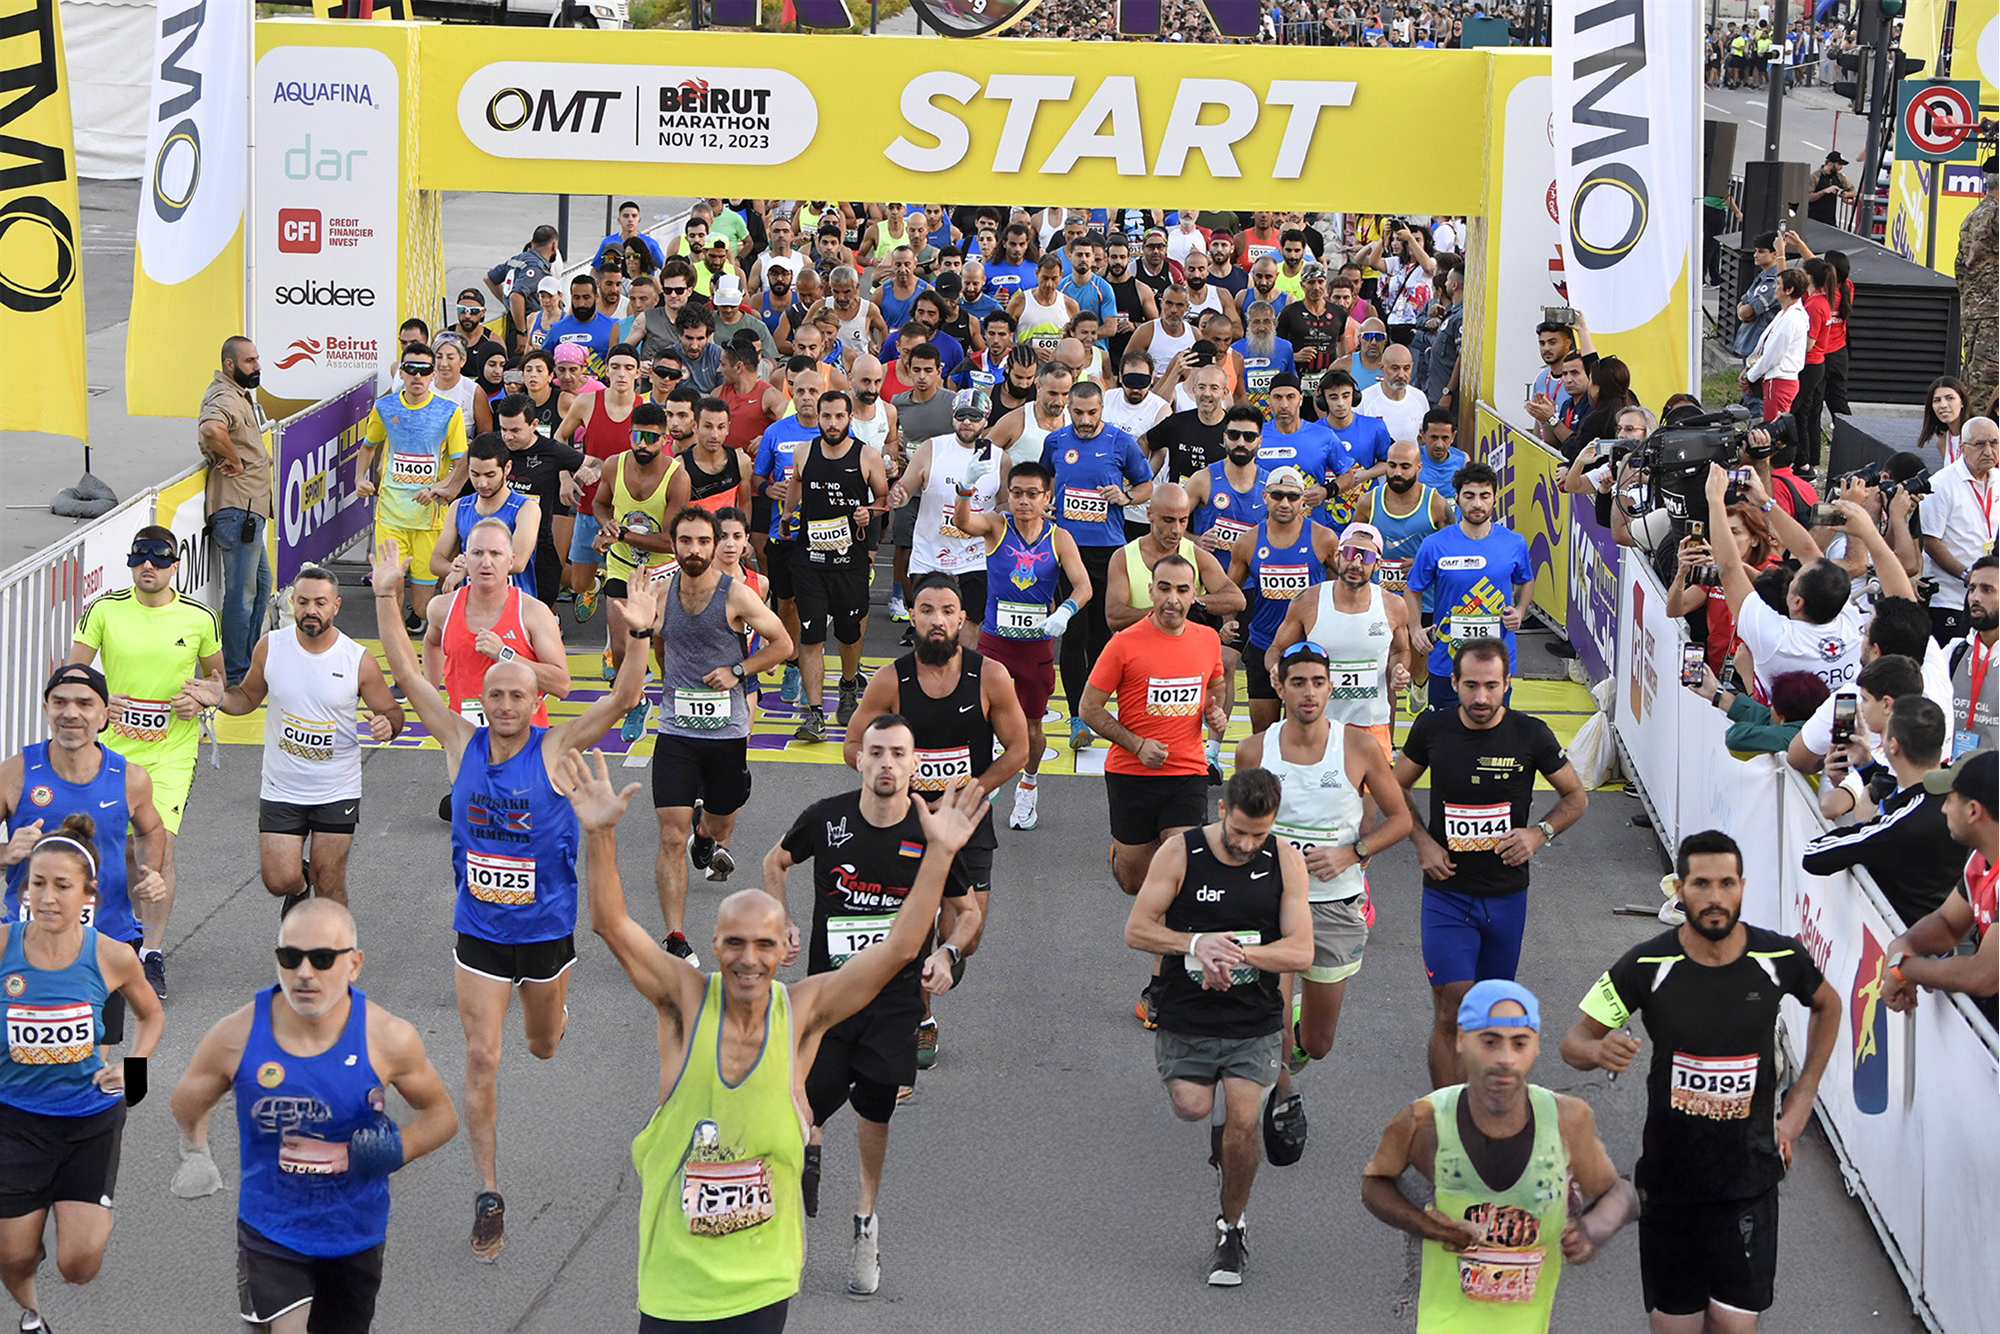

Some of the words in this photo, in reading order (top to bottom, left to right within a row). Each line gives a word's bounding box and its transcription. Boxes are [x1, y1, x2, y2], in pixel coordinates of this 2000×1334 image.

[273, 81, 373, 106] AQUAFINA
[659, 86, 771, 115] BEIRUT
[485, 87, 622, 134] OMT
[659, 115, 770, 131] MARATHON
[883, 71, 1357, 179] START
[659, 132, 694, 147] NOV
[699, 133, 724, 150] 12,
[729, 134, 770, 149] 2023
[284, 133, 368, 181] dar
[284, 220, 317, 242] CFI
[329, 218, 360, 228] CREDIT
[329, 228, 374, 238] FINANCIER
[329, 238, 359, 247] INVEST
[275, 280, 375, 307] solidere
[326, 336, 378, 351] Beirut
[1038, 340, 1059, 348] 608
[326, 350, 378, 361] MARATHON
[326, 360, 378, 370] Association
[394, 463, 433, 474] 11400
[283, 435, 340, 548] ONE
[1065, 498, 1106, 512] 10523
[810, 526, 849, 541] GUIDE
[1262, 576, 1307, 588] 10103
[1010, 615, 1033, 627] 116
[1462, 626, 1489, 638] 318
[1341, 673, 1359, 686] 21
[1151, 688, 1199, 703] 10127
[688, 702, 715, 716] 119
[284, 726, 333, 747] GUIDE
[1448, 819, 1508, 836] 10144
[470, 868, 530, 889] 10125
[853, 890, 879, 906] We
[1196, 885, 1226, 902] dar
[1802, 892, 1833, 976] Beirut
[11, 1022, 90, 1044] 10205
